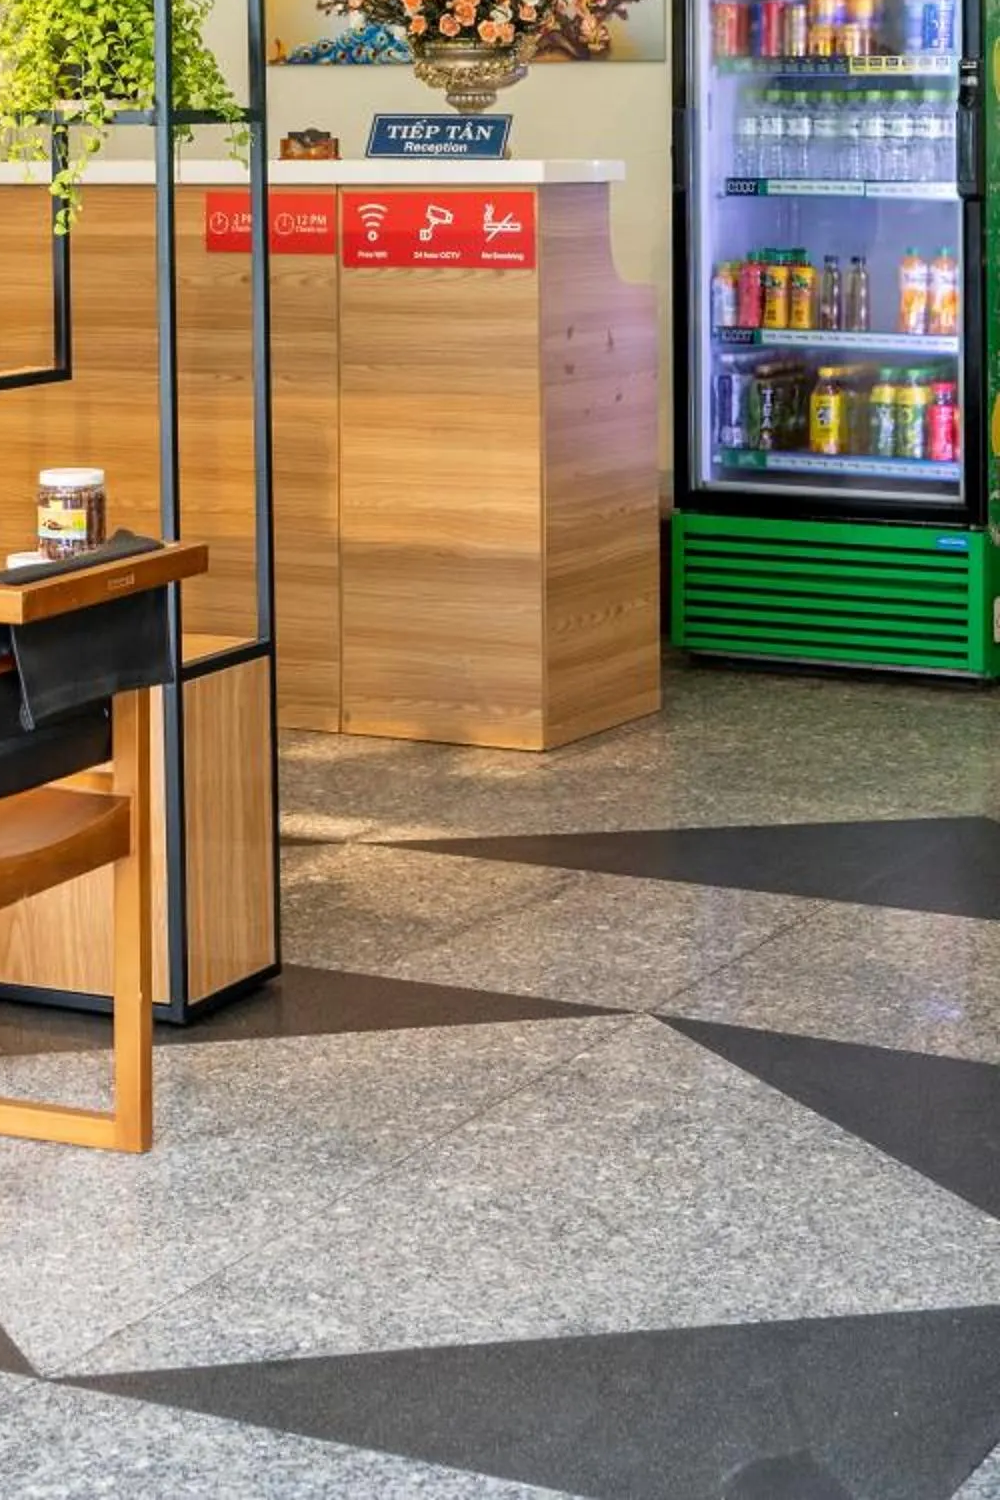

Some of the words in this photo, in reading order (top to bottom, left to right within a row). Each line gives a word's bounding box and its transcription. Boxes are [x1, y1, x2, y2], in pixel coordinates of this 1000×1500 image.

[387, 119, 440, 139] TIẾP
[445, 121, 494, 140] TÂN
[403, 141, 468, 154] Reception
[309, 214, 327, 226] PM
[414, 251, 423, 259] 24
[439, 251, 460, 259] CCTV
